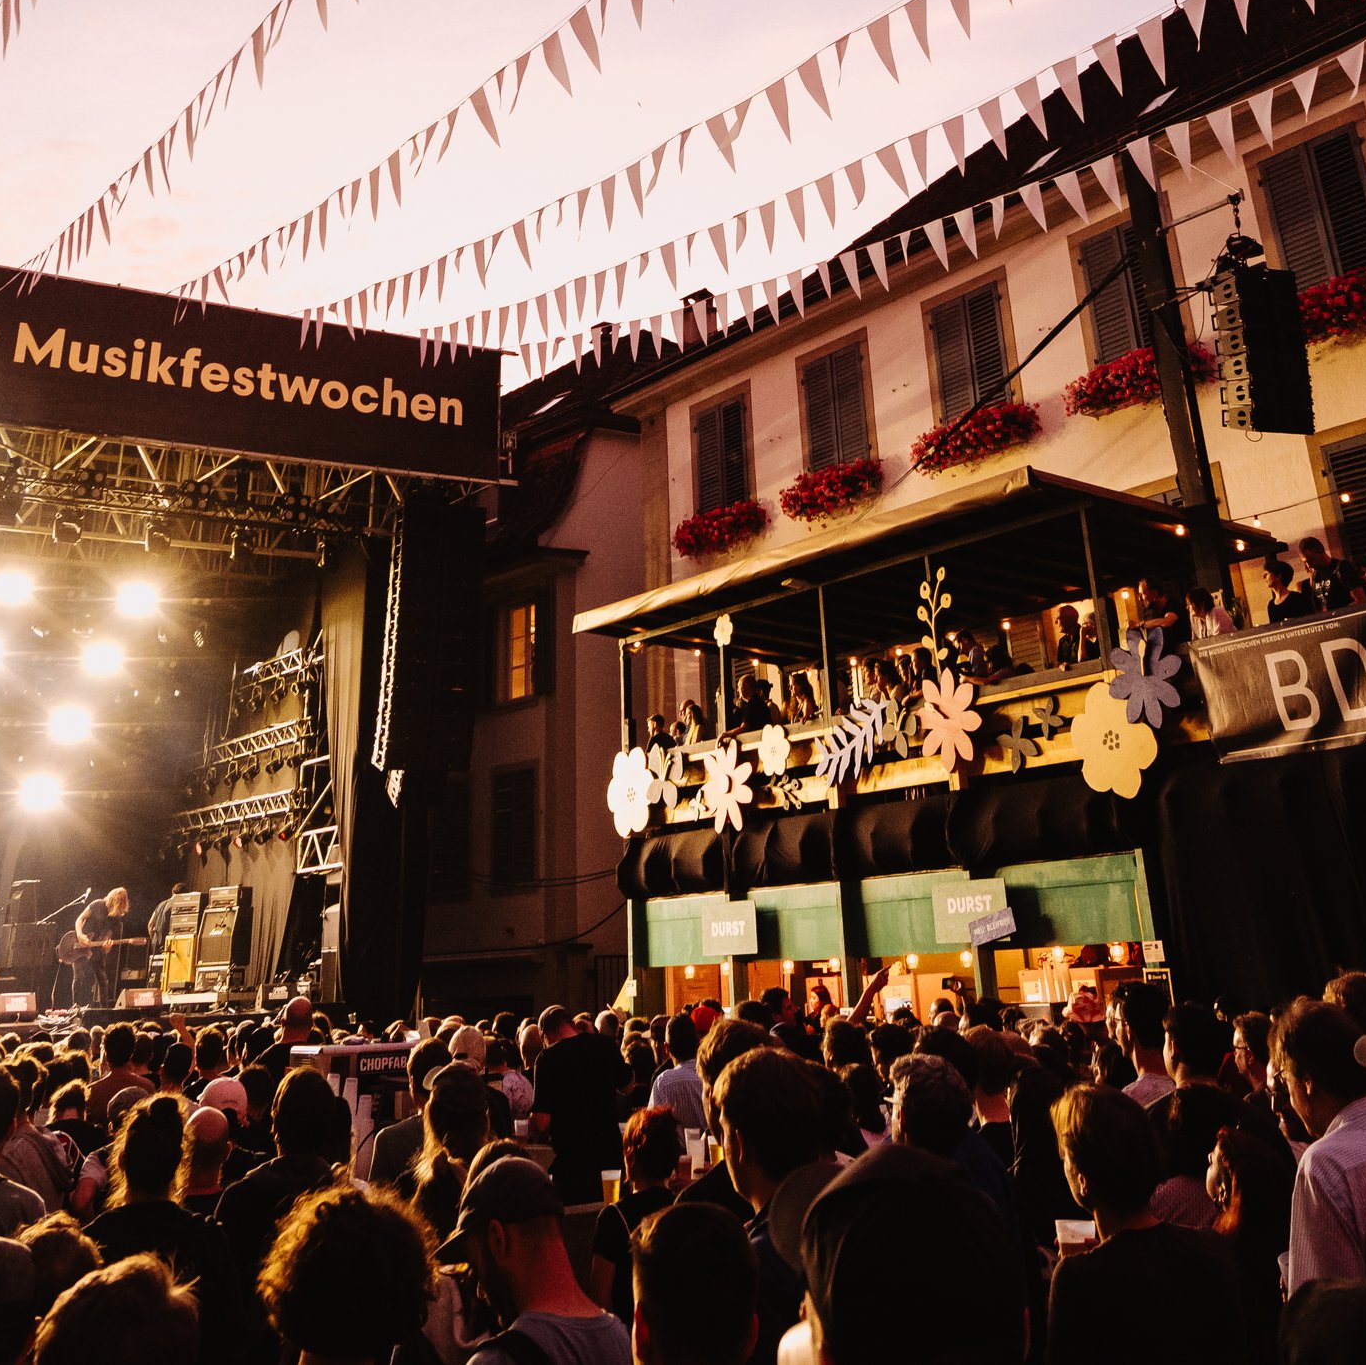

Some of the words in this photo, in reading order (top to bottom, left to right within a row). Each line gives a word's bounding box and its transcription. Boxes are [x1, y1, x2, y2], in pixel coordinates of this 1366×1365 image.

[13, 321, 465, 428] Musikfestwochen
[947, 894, 992, 914] DURST
[711, 920, 746, 937] DURST
[360, 1055, 408, 1072] CHOPFAB
